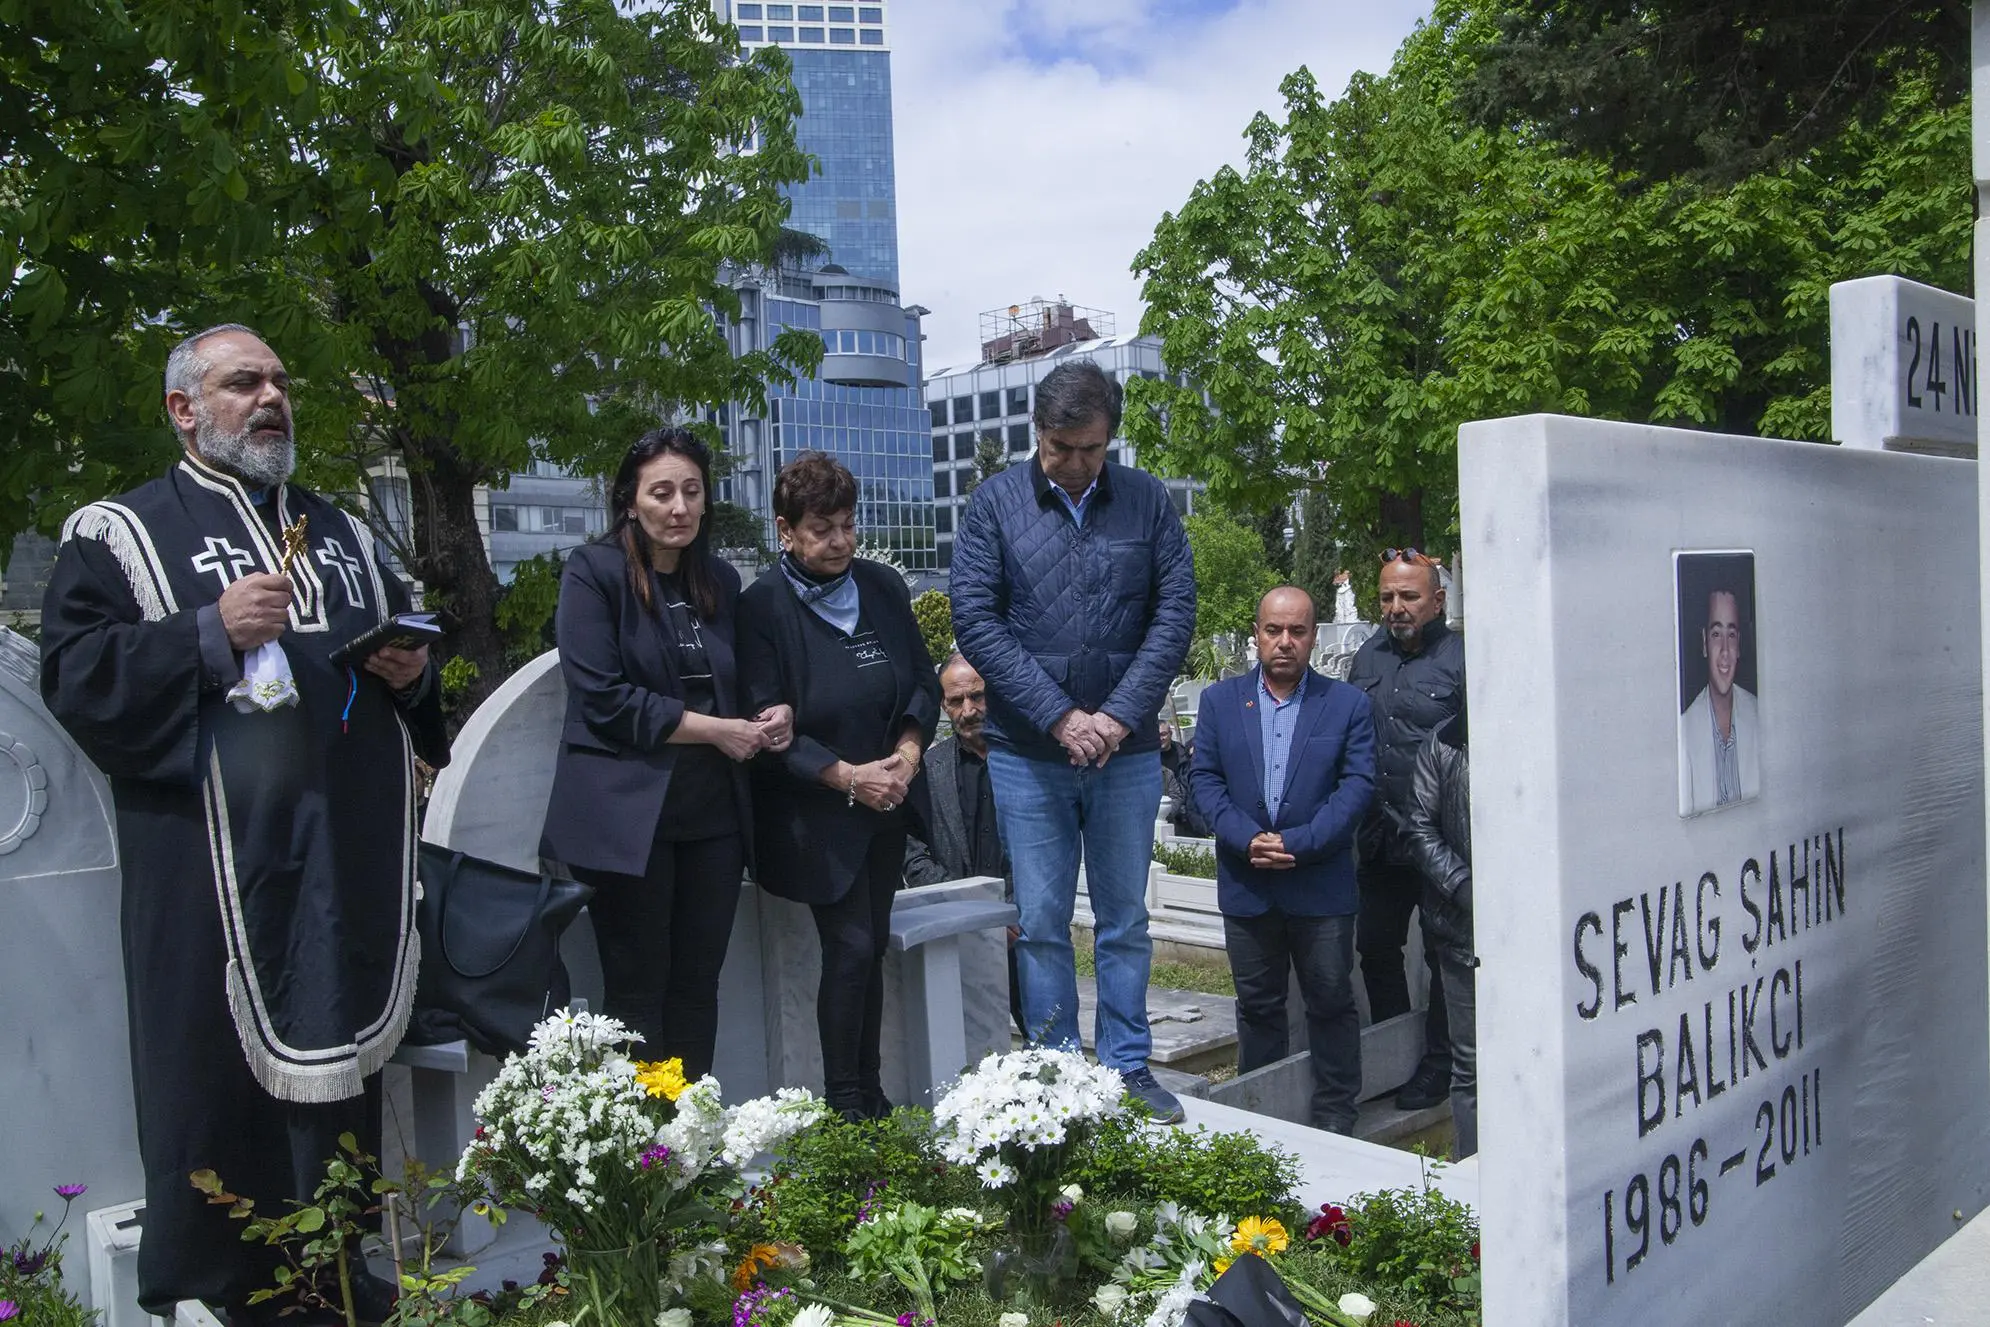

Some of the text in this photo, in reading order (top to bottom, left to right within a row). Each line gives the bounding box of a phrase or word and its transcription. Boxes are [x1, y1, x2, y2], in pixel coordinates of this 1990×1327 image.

[1906, 315, 1947, 412] 24
[1574, 871, 1721, 1021] SEVAG
[1636, 960, 1804, 1138] BALIKCI
